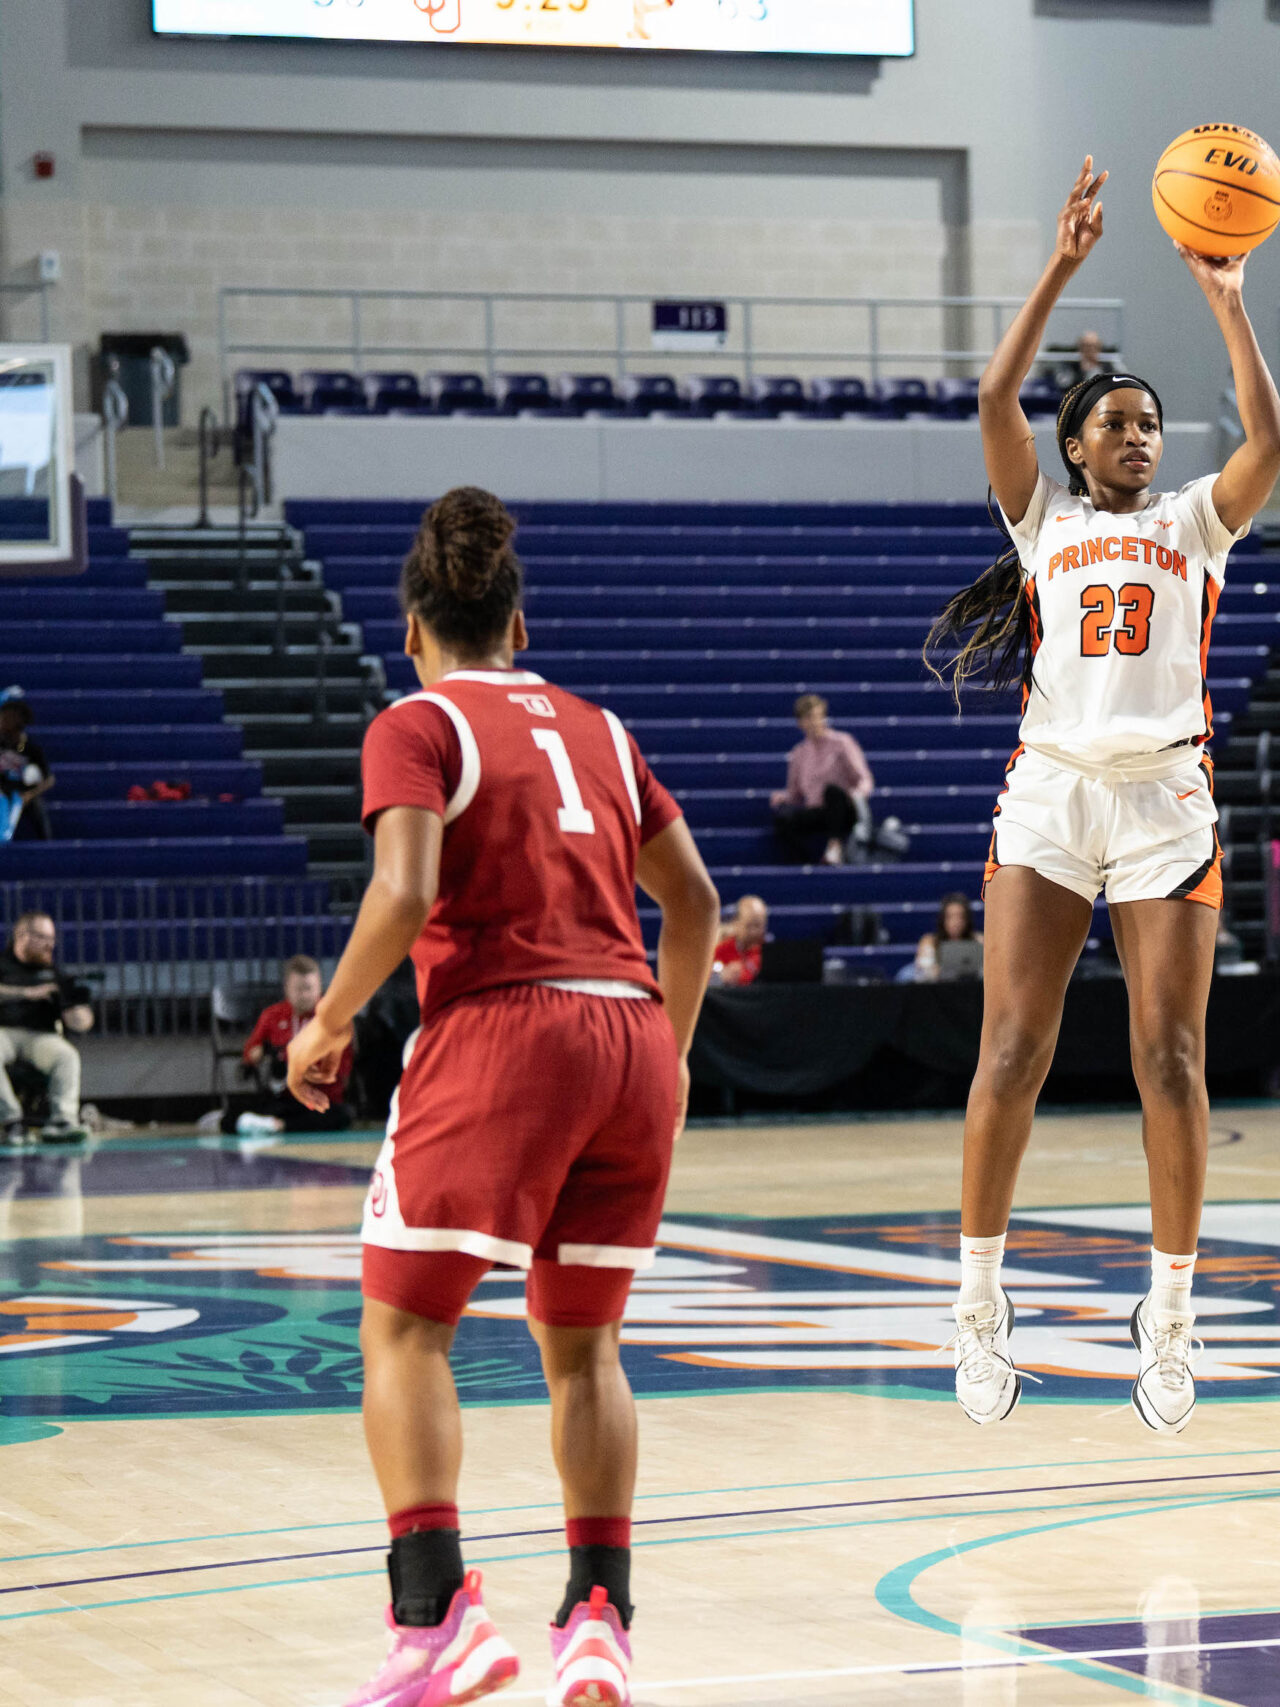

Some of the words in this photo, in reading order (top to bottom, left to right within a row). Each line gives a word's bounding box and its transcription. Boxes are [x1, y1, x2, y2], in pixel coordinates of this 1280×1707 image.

[1204, 148, 1259, 176] EVO
[1048, 536, 1187, 581] PRINCETON
[1080, 583, 1155, 657] 23
[530, 728, 595, 835] 1
